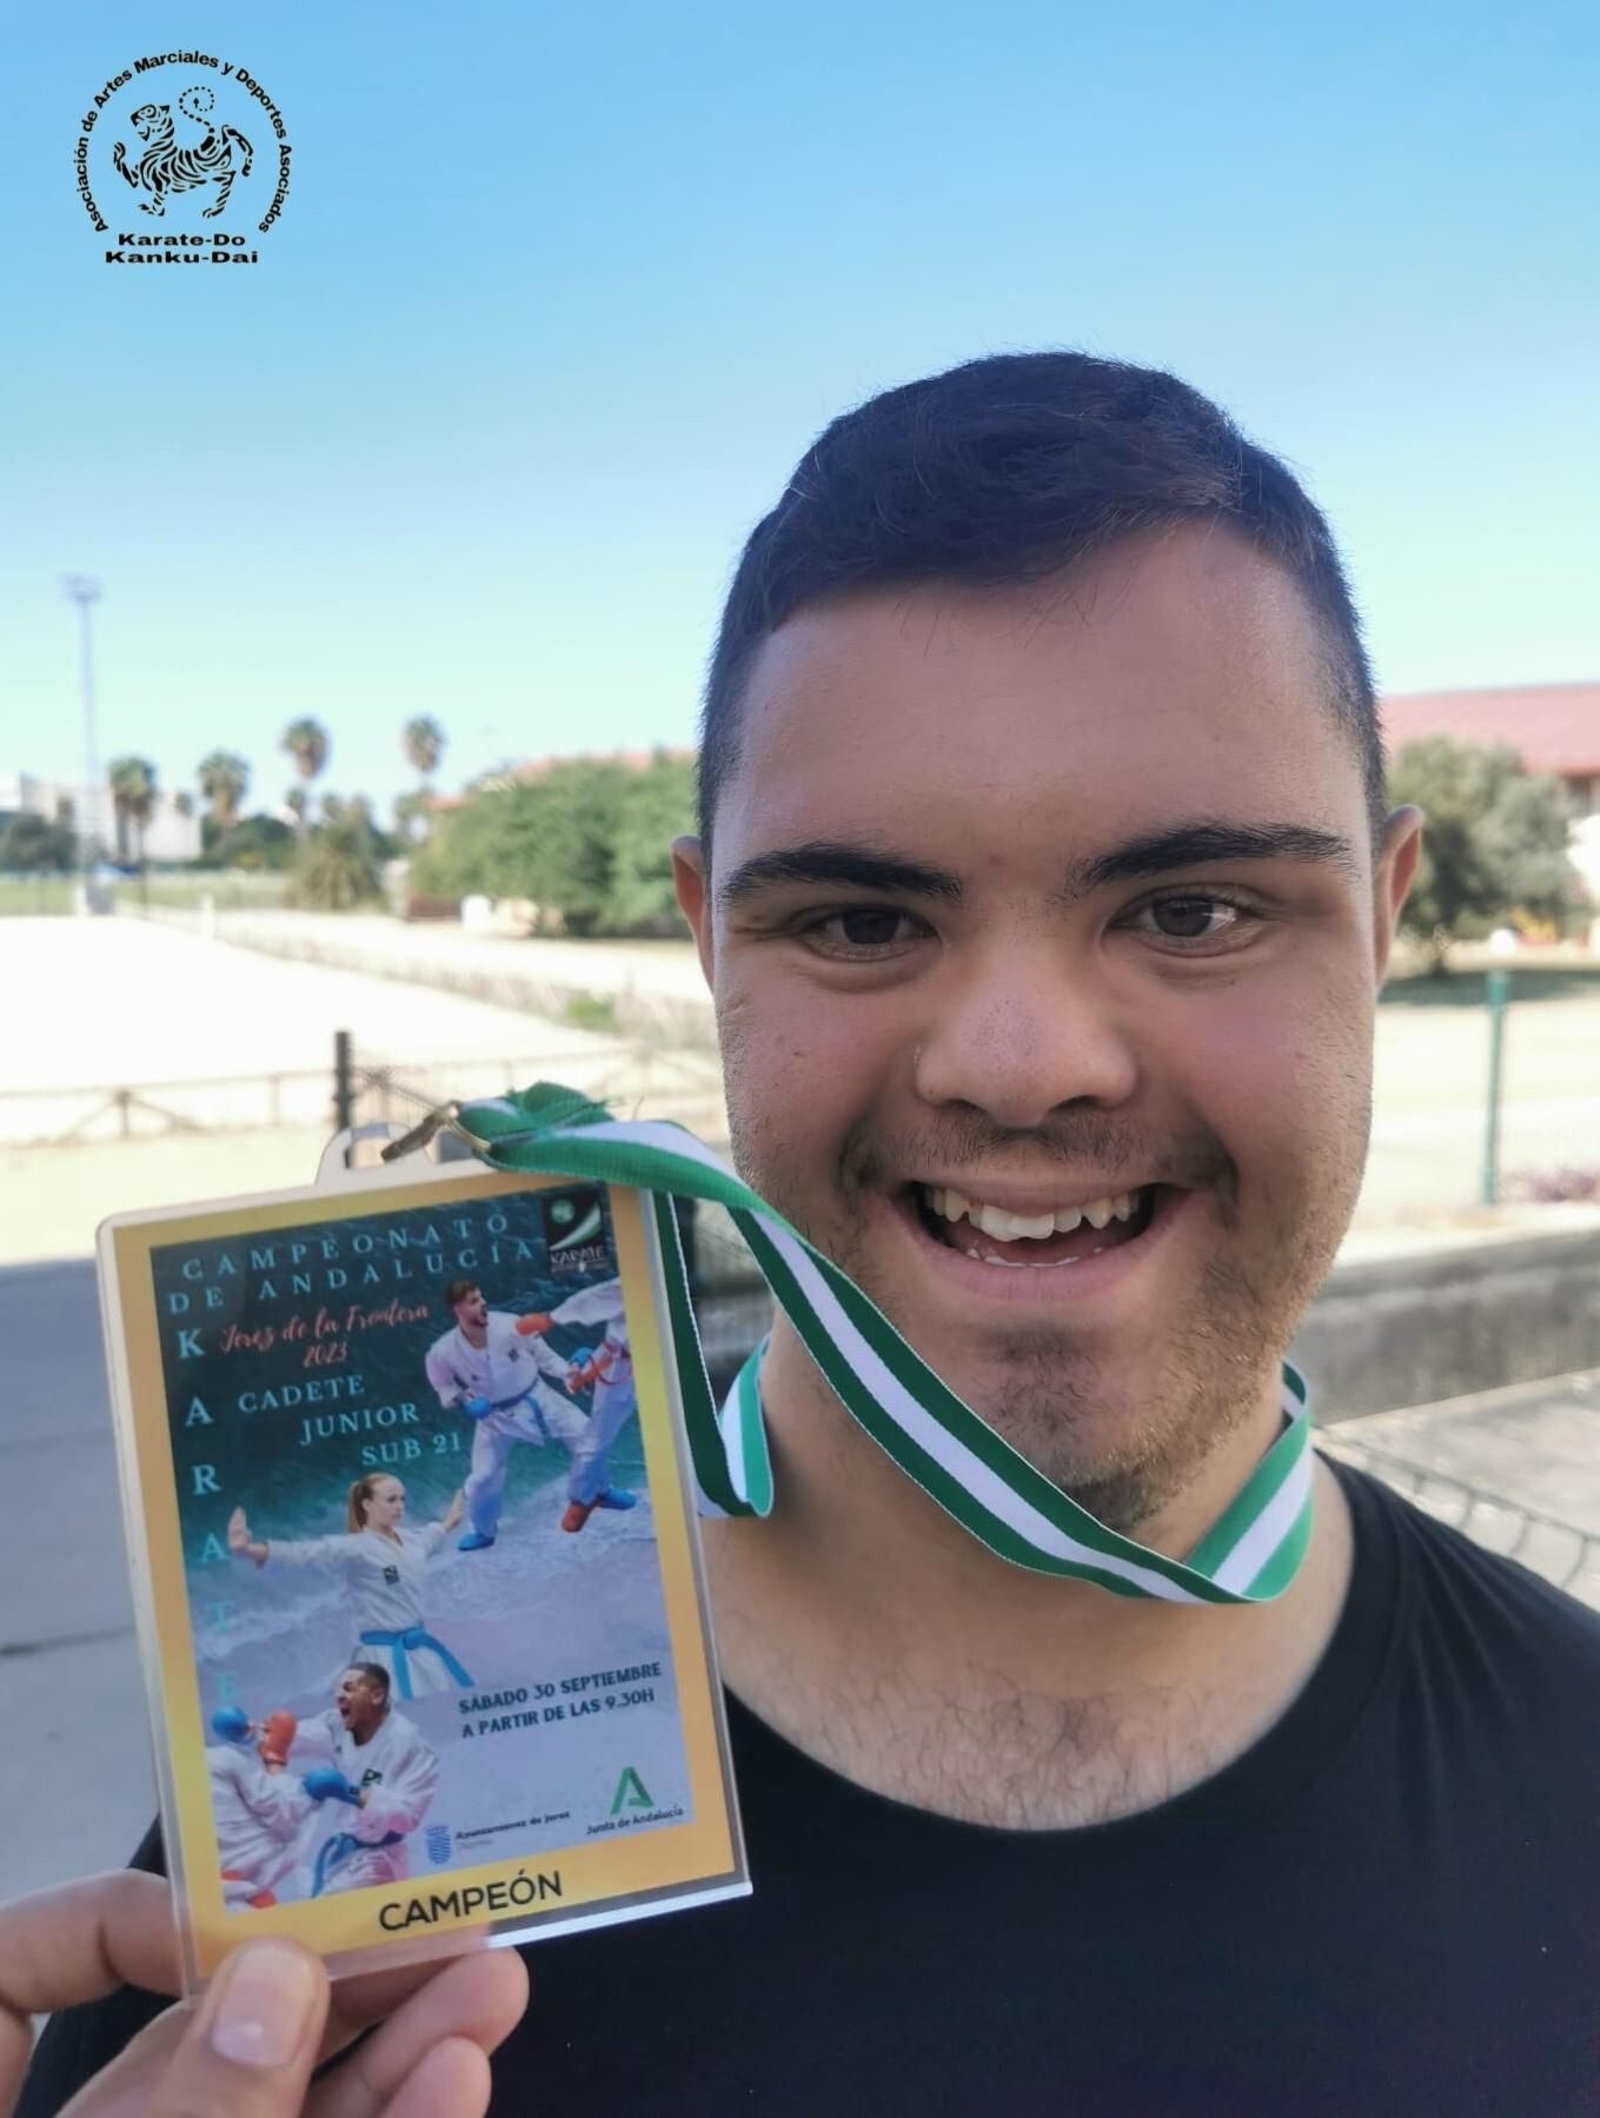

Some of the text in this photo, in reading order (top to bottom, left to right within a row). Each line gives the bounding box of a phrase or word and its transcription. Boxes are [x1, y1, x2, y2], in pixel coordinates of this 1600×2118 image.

[183, 1214, 507, 1281] CAMPEONATO
[169, 1286, 224, 1314] DE
[282, 1315, 305, 1341] de
[315, 1306, 339, 1338] la
[238, 1374, 366, 1413] CADETE
[300, 1402, 420, 1446] JUNIOR
[361, 1431, 460, 1466] SUB 21
[459, 1662, 662, 1714] SÁBADO 30 SEPTIEMBRE
[462, 1723, 474, 1738] A
[479, 1711, 539, 1735] PARTIR
[544, 1707, 565, 1723] DE
[570, 1698, 601, 1717] LAS
[586, 1806, 684, 1836] Junta de Andalucía
[379, 1868, 562, 1931] CAMPEÓN
